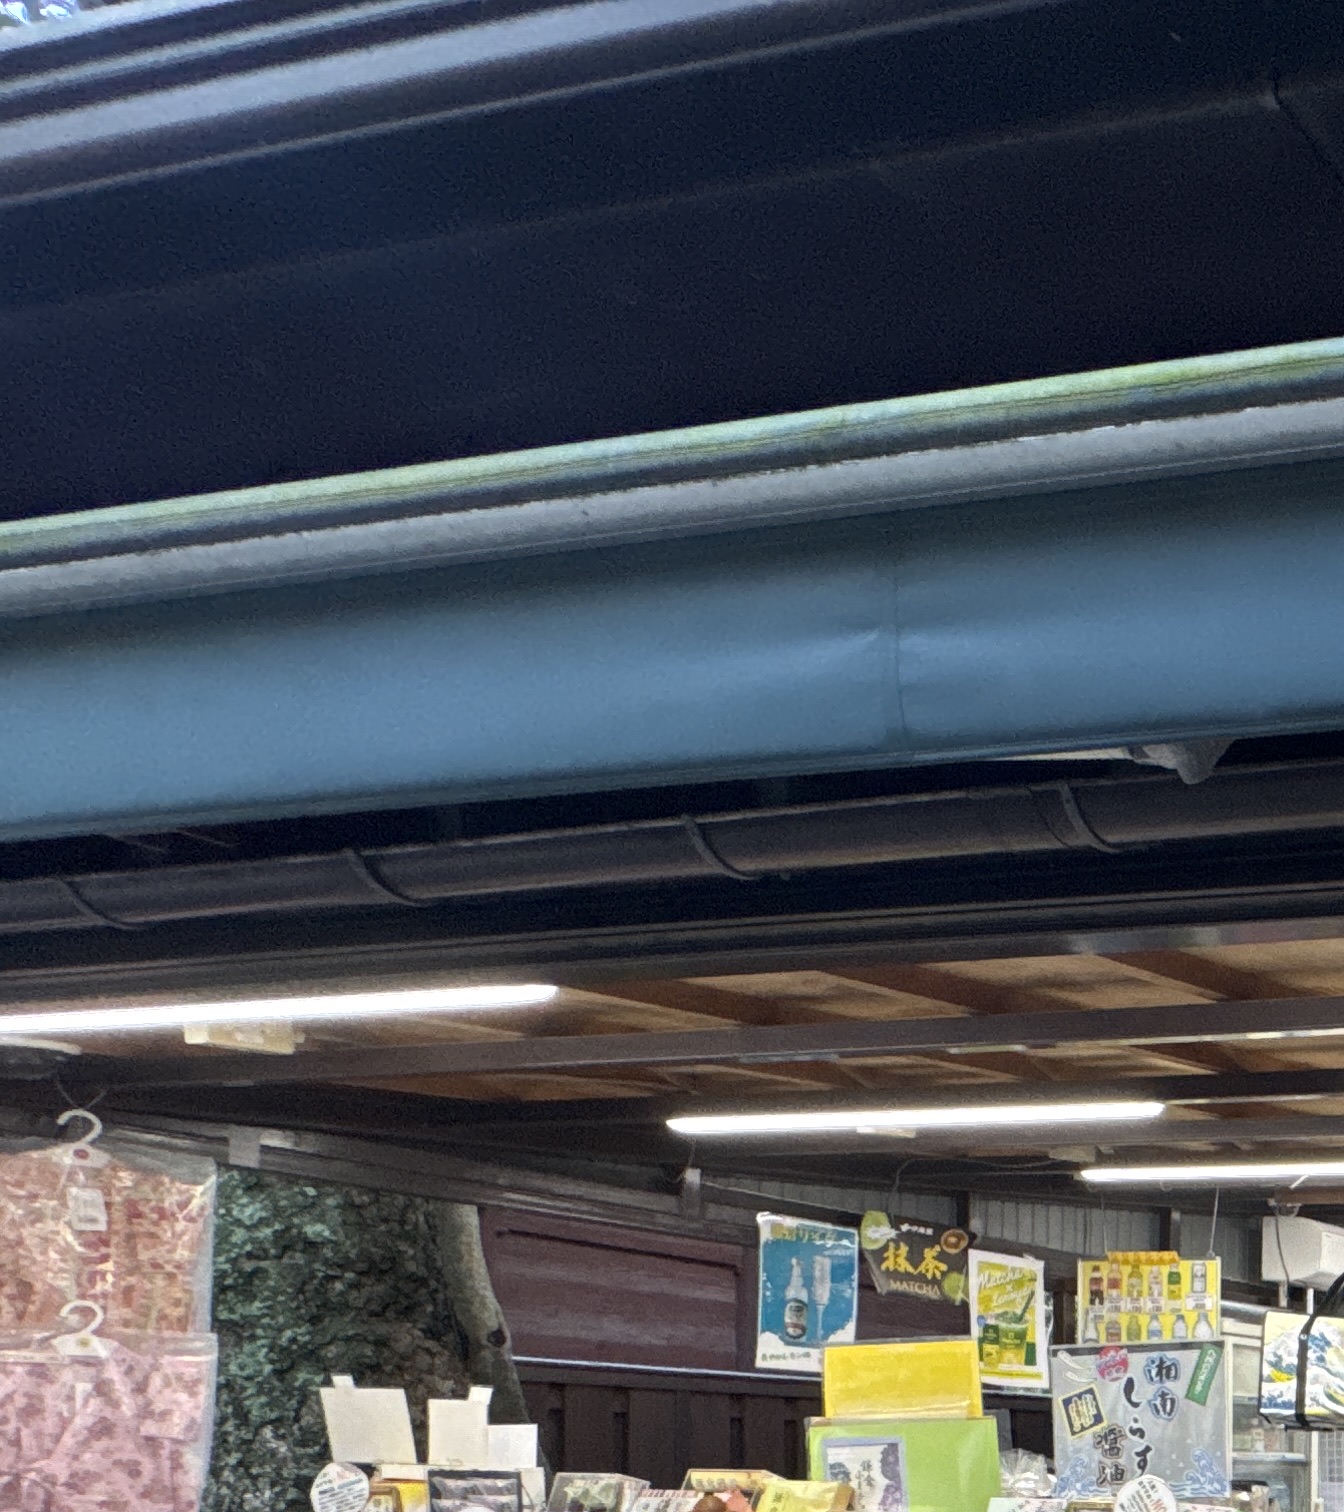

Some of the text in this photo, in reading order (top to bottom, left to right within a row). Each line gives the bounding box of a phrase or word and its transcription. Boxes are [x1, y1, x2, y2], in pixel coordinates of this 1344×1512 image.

[881, 1242, 948, 1280] 抹茶
[890, 1279, 941, 1296] MATCHA
[1146, 1356, 1180, 1418] 湘南
[1123, 1376, 1153, 1475] しらす
